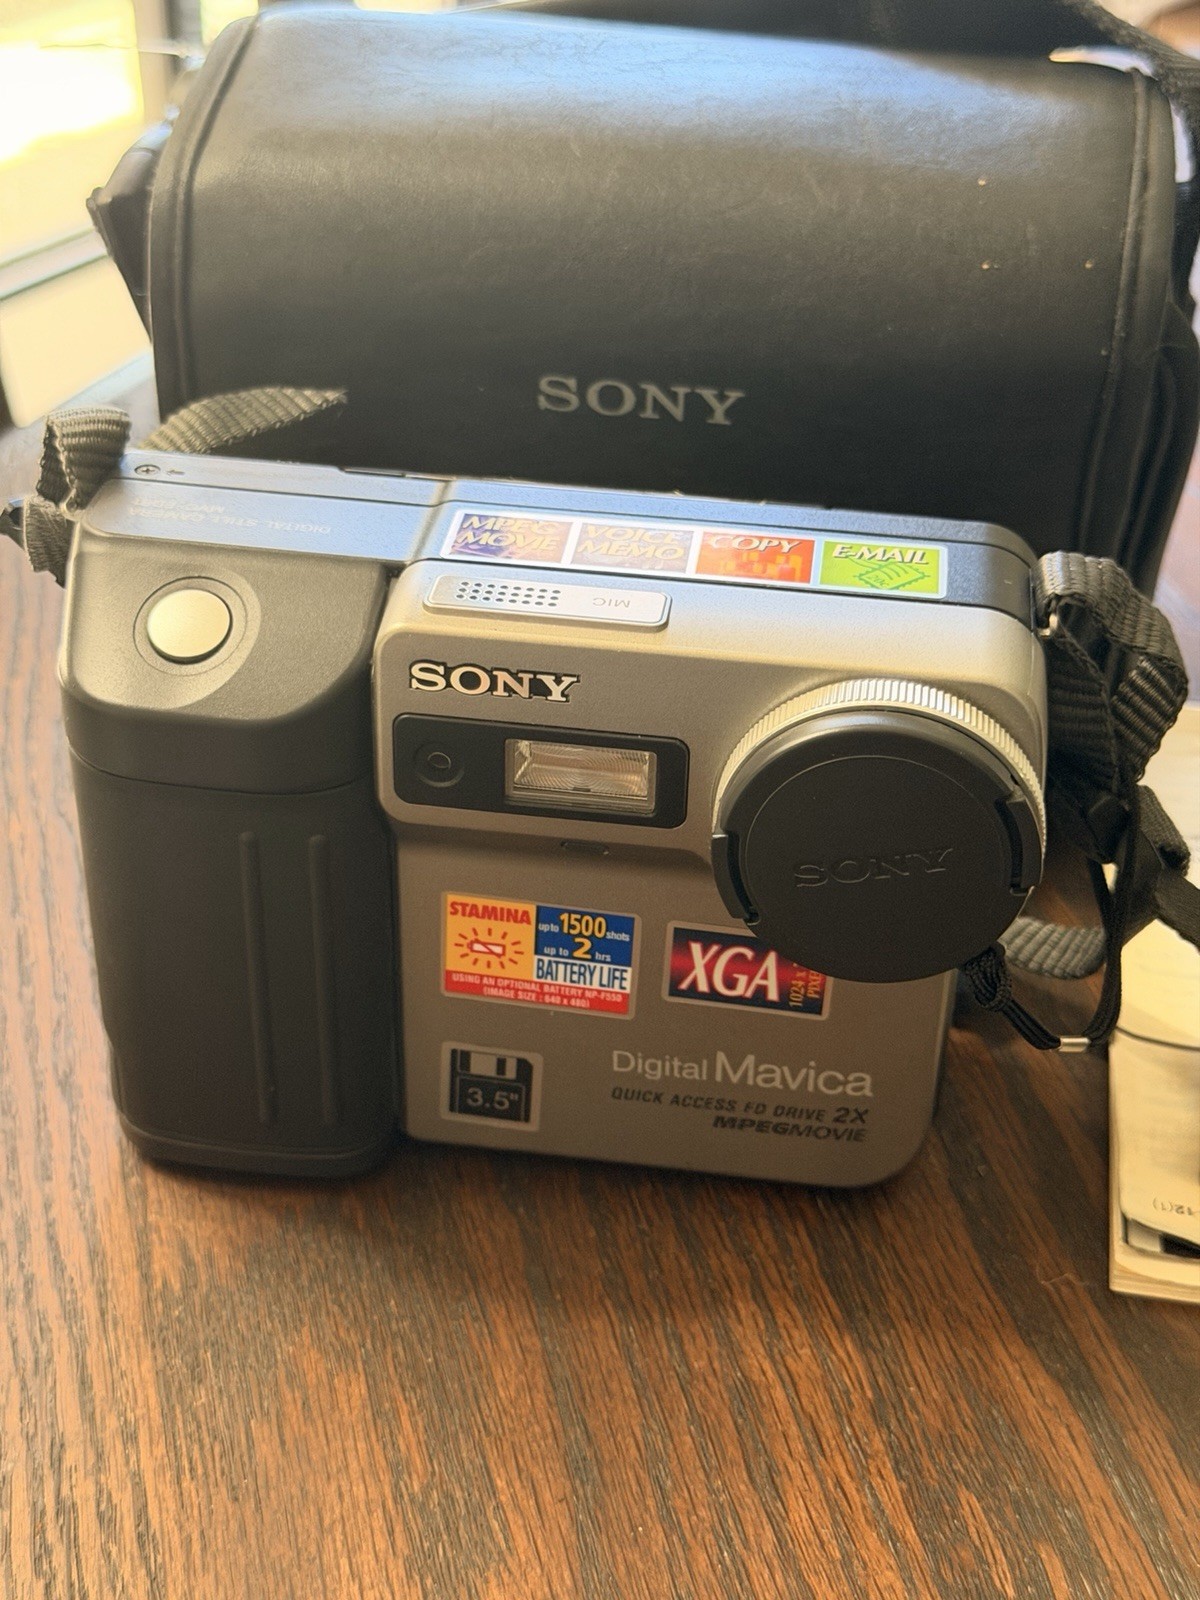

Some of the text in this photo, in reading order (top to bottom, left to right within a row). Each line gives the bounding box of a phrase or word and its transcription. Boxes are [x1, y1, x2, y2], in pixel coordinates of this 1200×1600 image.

[537, 375, 746, 426] SONY
[462, 515, 559, 536] MPEG
[586, 524, 682, 545] VOICE
[455, 531, 561, 551] MOVIE
[576, 540, 685, 560] MEMO
[708, 534, 801, 554] COPY
[832, 543, 929, 565] E-MAIL
[592, 597, 631, 609] MIC
[409, 660, 580, 702] SONY
[794, 848, 954, 888] SONY
[449, 901, 532, 926] STAMINA
[559, 912, 607, 938] 1500
[605, 930, 631, 942] shots
[543, 937, 612, 962] up to 2 hrs
[536, 958, 629, 990] BATTERY LIFE
[678, 941, 780, 1002] XGA
[452, 973, 481, 985] USING
[482, 977, 496, 986] AN
[497, 980, 541, 993] OPTIONAL
[543, 983, 583, 997] BATTERY
[483, 986, 515, 999] (IMAGE
[517, 991, 536, 1001] SIZE
[789, 977, 806, 1007] 1024
[806, 971, 820, 999] PIXE
[611, 1050, 874, 1097] Digital Mavica
[466, 1086, 519, 1111] 3.5"
[611, 1086, 869, 1124] QUICK ACCESS FD DRIVE 2X
[712, 1115, 867, 1142] MPEGMOVIE
